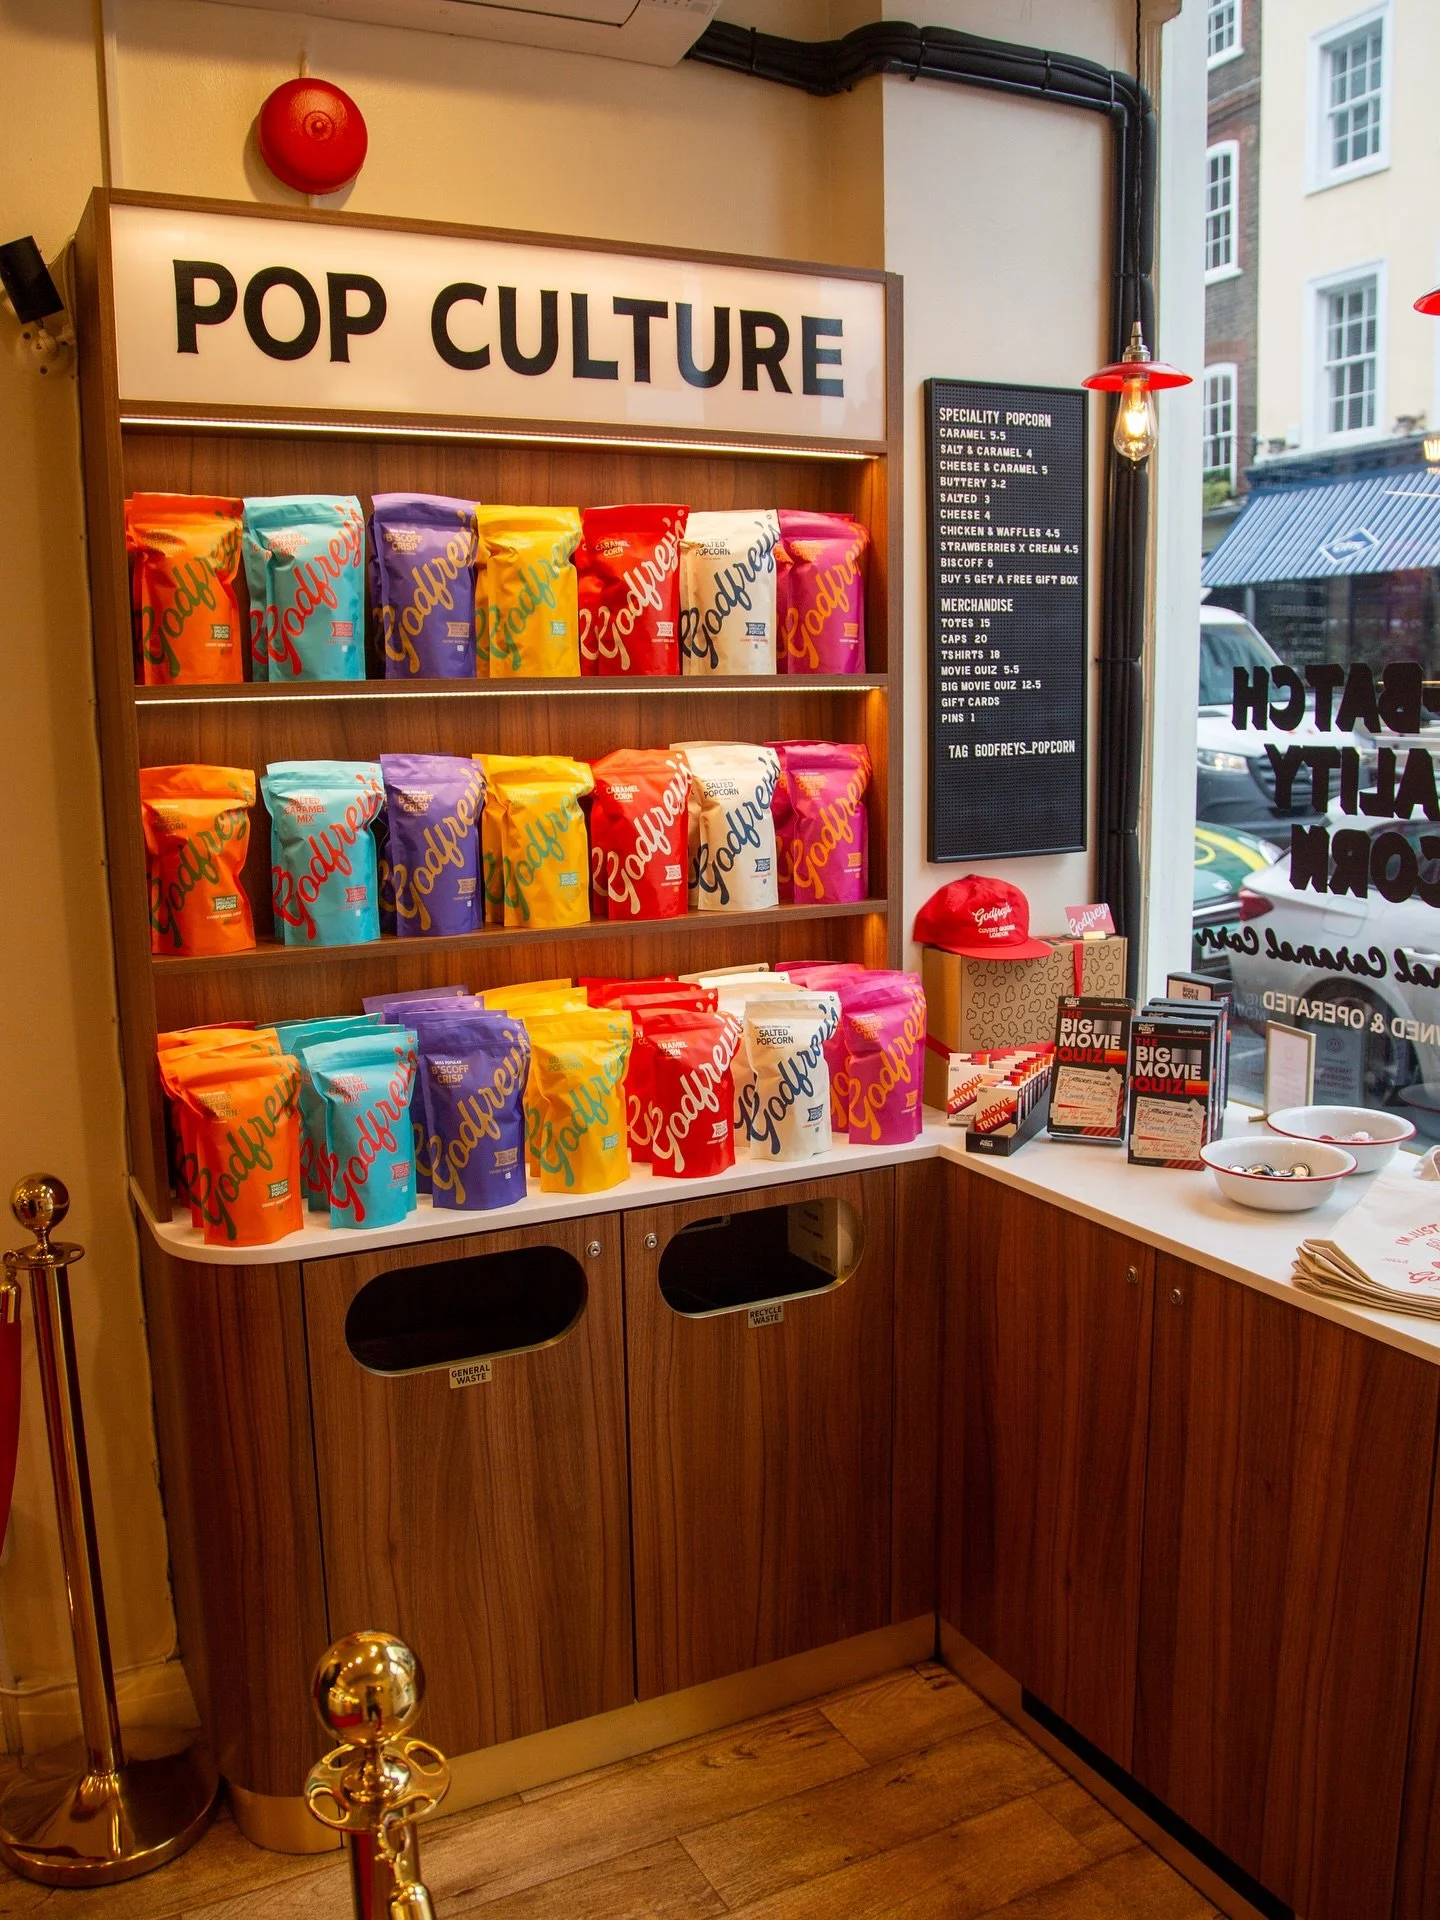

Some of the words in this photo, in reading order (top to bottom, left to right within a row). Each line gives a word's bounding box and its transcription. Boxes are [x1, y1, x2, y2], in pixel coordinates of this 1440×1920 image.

[173, 259, 387, 362] POP
[430, 281, 845, 398] CULTURE
[939, 408, 1000, 425] SPECIALITY
[1006, 412, 1051, 427] POPCORN
[939, 428, 985, 440] CARAMEL
[990, 431, 1006, 440] 5.5
[941, 445, 963, 454] SALT
[967, 446, 973, 455] &
[977, 447, 1022, 457] CARAMEL
[1026, 449, 1032, 458] 4
[940, 461, 979, 472] CHEESE
[984, 463, 990, 472] &
[993, 464, 1038, 474] CARAMEL
[1042, 466, 1047, 474] 5
[940, 477, 986, 488] BUTTERY
[991, 479, 1006, 488] 3.2
[940, 494, 977, 503] SALTED
[985, 495, 990, 503] 3
[941, 510, 979, 519] CHEESE
[985, 511, 990, 519] 4
[941, 526, 984, 536] CHICKEN
[988, 527, 993, 536] &
[997, 528, 1041, 537] WAFFLES
[1045, 529, 1060, 537] 4.5
[392, 542, 417, 551] CRISP
[595, 539, 630, 551] CARAMEL
[941, 542, 1015, 552] STRAWBERRIES
[1019, 544, 1025, 552] X
[1029, 544, 1060, 553] CREAM
[1064, 544, 1079, 553] 4.5
[603, 547, 623, 556] CORN
[695, 548, 731, 556] POPCORN
[941, 558, 983, 568] BISCOFF
[987, 559, 993, 567] 6
[941, 575, 960, 584] BUY
[965, 575, 970, 583] 5
[975, 575, 993, 584] GET
[997, 576, 1003, 584] A
[1007, 575, 1032, 584] FREE
[1035, 575, 1057, 584] GIFT
[1061, 576, 1078, 585] BOX
[941, 598, 1013, 612] MERCHANDISE
[941, 618, 973, 628] TOTES
[980, 618, 990, 627] 15
[941, 634, 967, 644] CAPS
[974, 635, 988, 643] 20
[941, 650, 983, 659] TSHIRTS
[990, 650, 1000, 659] 18
[941, 666, 970, 675] MOVIE
[974, 666, 997, 675] QUIZ
[1004, 665, 1019, 674] 5.5
[941, 682, 958, 691] BIG
[961, 682, 990, 691] MOVIE
[994, 681, 1016, 690] QUIZ
[1022, 680, 1041, 689] 12.5
[941, 697, 965, 707] GIFT
[968, 697, 1000, 706] CARDS
[941, 713, 964, 723] PINS
[971, 713, 975, 722] 1
[949, 745, 968, 758] TAG
[975, 740, 1075, 757] GODFREYS_POPCORN
[606, 785, 640, 794] CARAMEL
[703, 789, 739, 798] POPCORN
[289, 797, 320, 805] SALTED
[284, 805, 327, 814] CARAMEL
[403, 803, 429, 811] CRISP
[297, 814, 314, 823] MIX
[1061, 1010, 1082, 1018] THE
[1061, 1018, 1093, 1033] BIG
[759, 1029, 788, 1037] SALTED
[756, 1036, 793, 1045] POPCORN
[1059, 1033, 1120, 1049] MOVIE
[1135, 1038, 1158, 1047] THE
[1058, 1048, 1104, 1062] QUIZ
[1136, 1046, 1170, 1062] BIG
[1135, 1061, 1201, 1080] MOVIE
[332, 1075, 363, 1086] SALTED
[437, 1074, 463, 1083] CRISP
[328, 1085, 371, 1095] CARAMEL
[954, 1074, 983, 1096] MOVIE
[1135, 1077, 1184, 1095] QUIZ
[343, 1094, 360, 1104] MIX
[950, 1087, 979, 1109] TRIVIA
[981, 1097, 1011, 1117] MOVIE
[431, 1031, 531, 1205] Godfrey's
[977, 1110, 1009, 1131] TRIVIA
[750, 1306, 781, 1318] RECYCLE
[753, 1314, 779, 1325] WASTE
[452, 1365, 490, 1377] GENERAL
[456, 1373, 486, 1384] WASTE
